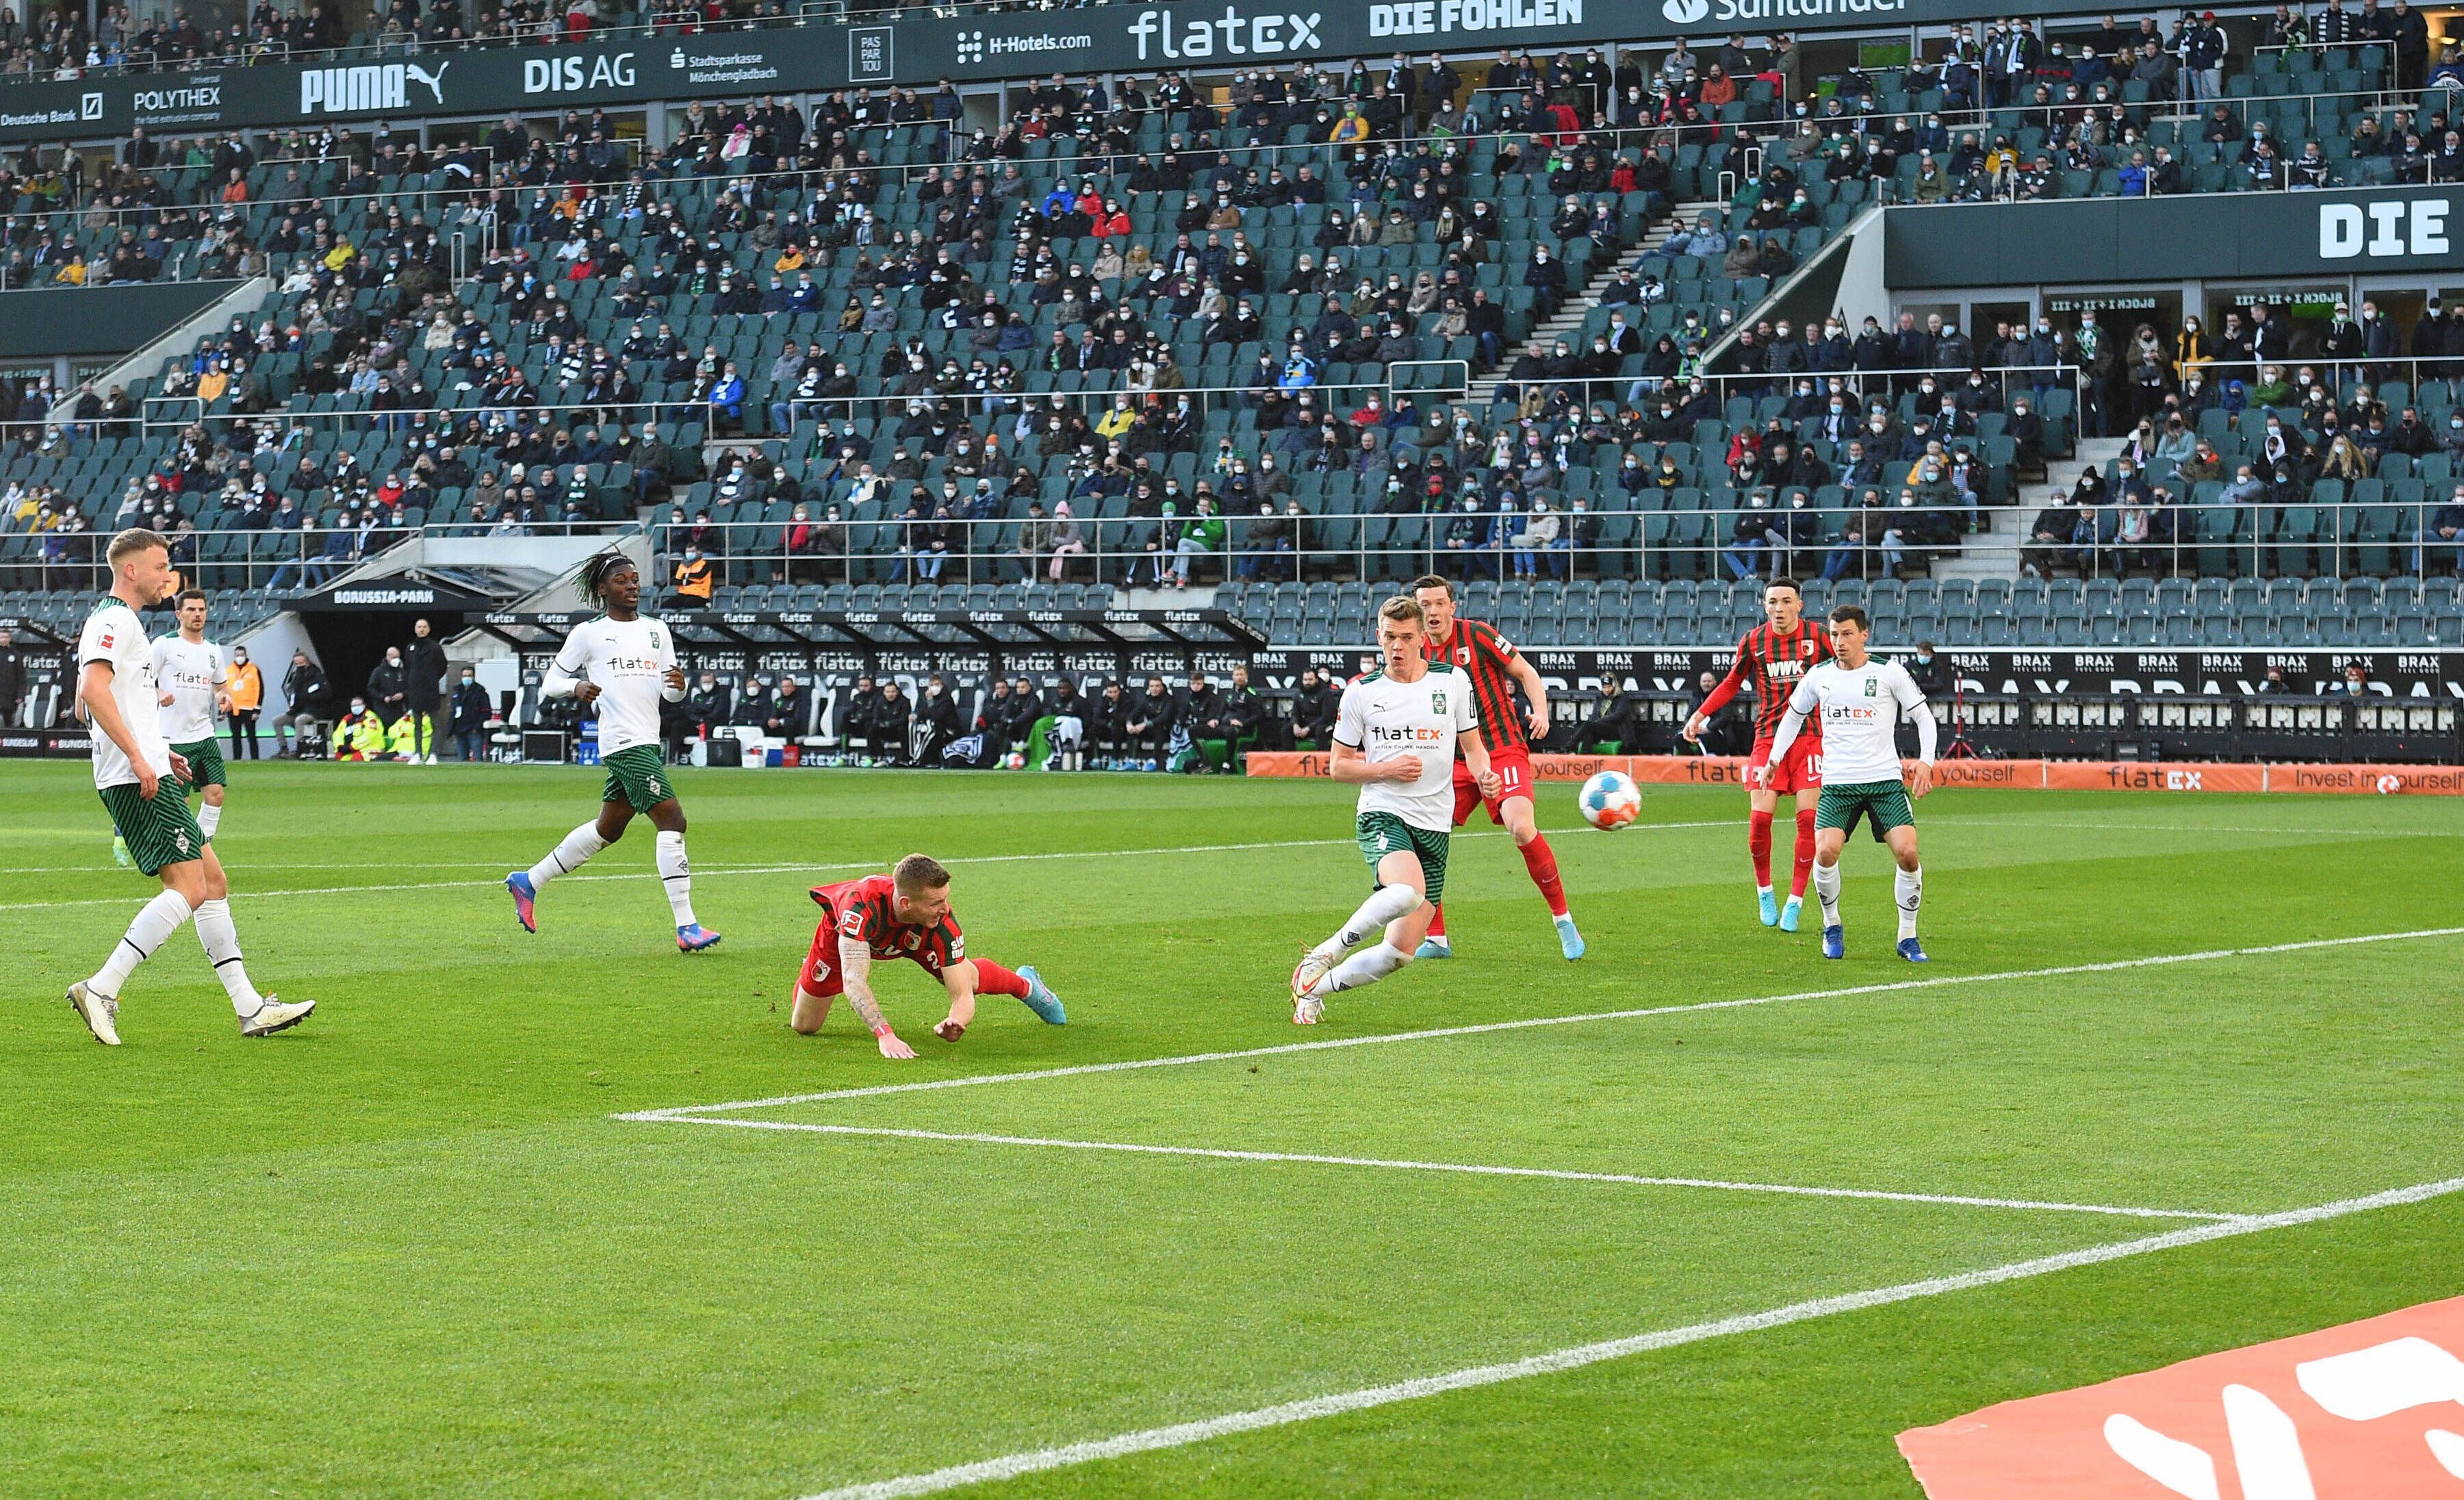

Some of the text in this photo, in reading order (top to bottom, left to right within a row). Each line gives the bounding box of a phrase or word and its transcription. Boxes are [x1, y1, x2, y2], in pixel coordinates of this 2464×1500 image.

[1370, 1, 1435, 37] DIE
[860, 36, 881, 49] PAS
[989, 32, 1091, 54] H-Hotels.com
[689, 53, 762, 68] Stadtsparkasse
[860, 49, 881, 61] PAR
[524, 52, 636, 93] DIS AG
[860, 60, 881, 72] TOU
[689, 67, 778, 84] Mönchengladbach
[301, 64, 406, 114] PUMA
[133, 87, 221, 111] POLYTHEX
[1, 109, 77, 127] Deutsche Bank
[2320, 199, 2450, 259] DIE
[334, 589, 434, 604] BORUSSIA-PARK
[1253, 653, 1287, 663] BRAX
[1310, 653, 1344, 663] BRAX
[1540, 653, 1575, 665] BRAX
[1597, 653, 1633, 665] BRAX
[1654, 653, 1691, 665] BRAX
[1951, 654, 1990, 666] BRAX
[2012, 654, 2051, 666] BRAX
[2075, 654, 2114, 666] BRAX
[2138, 654, 2178, 667] BRAX
[2202, 655, 2242, 667] BRAX
[2267, 655, 2307, 668] BRAX
[2332, 655, 2373, 668] BRX
[2398, 655, 2439, 668] BRAX
[1767, 660, 1804, 678] WWK
[1503, 759, 1519, 785] 11
[1940, 764, 2015, 785] yourself
[2296, 770, 2464, 790] Invest in ourself
